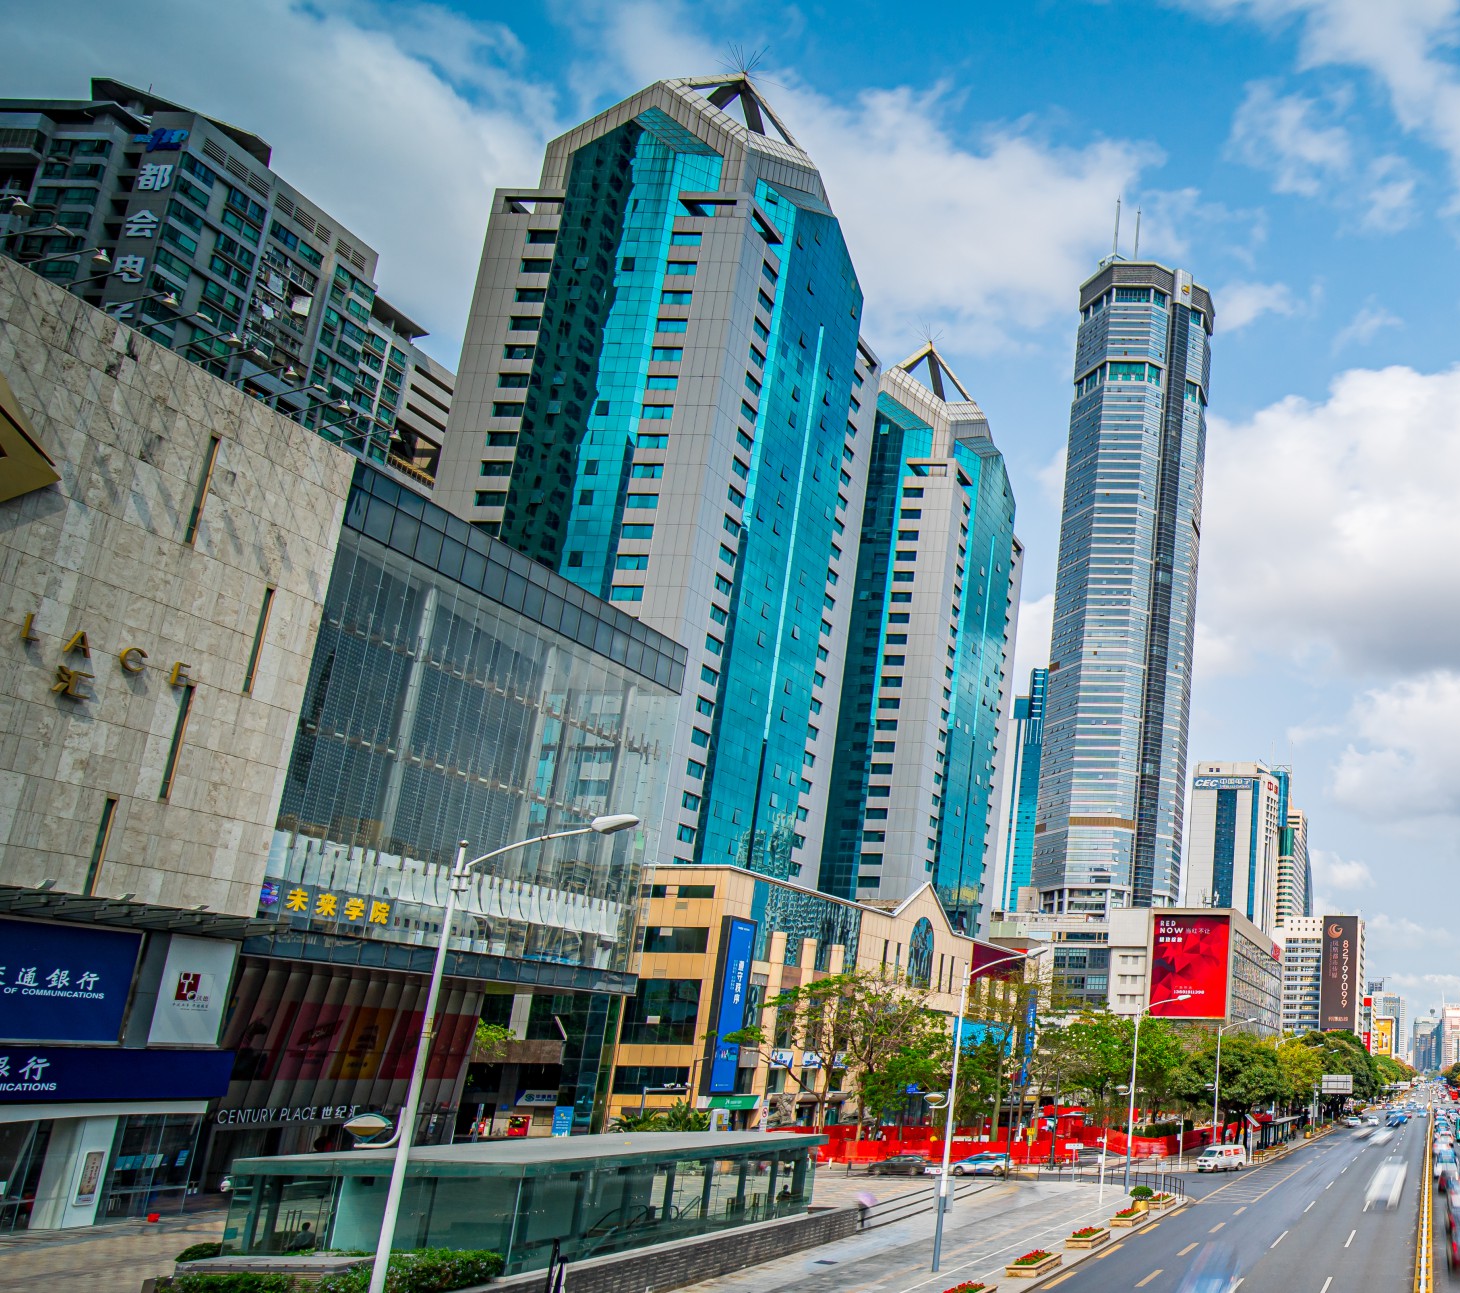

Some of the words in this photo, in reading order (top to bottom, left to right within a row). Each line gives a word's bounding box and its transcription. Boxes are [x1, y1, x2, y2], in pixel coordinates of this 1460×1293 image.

[1194, 779, 1218, 787] CEC
[286, 887, 391, 925] 未来学院
[1341, 940, 1349, 1008] 82799099
[22, 988, 105, 999] COMMUNICATIONS
[217, 1108, 277, 1124] CENTURY
[279, 1106, 318, 1121] PLACE
